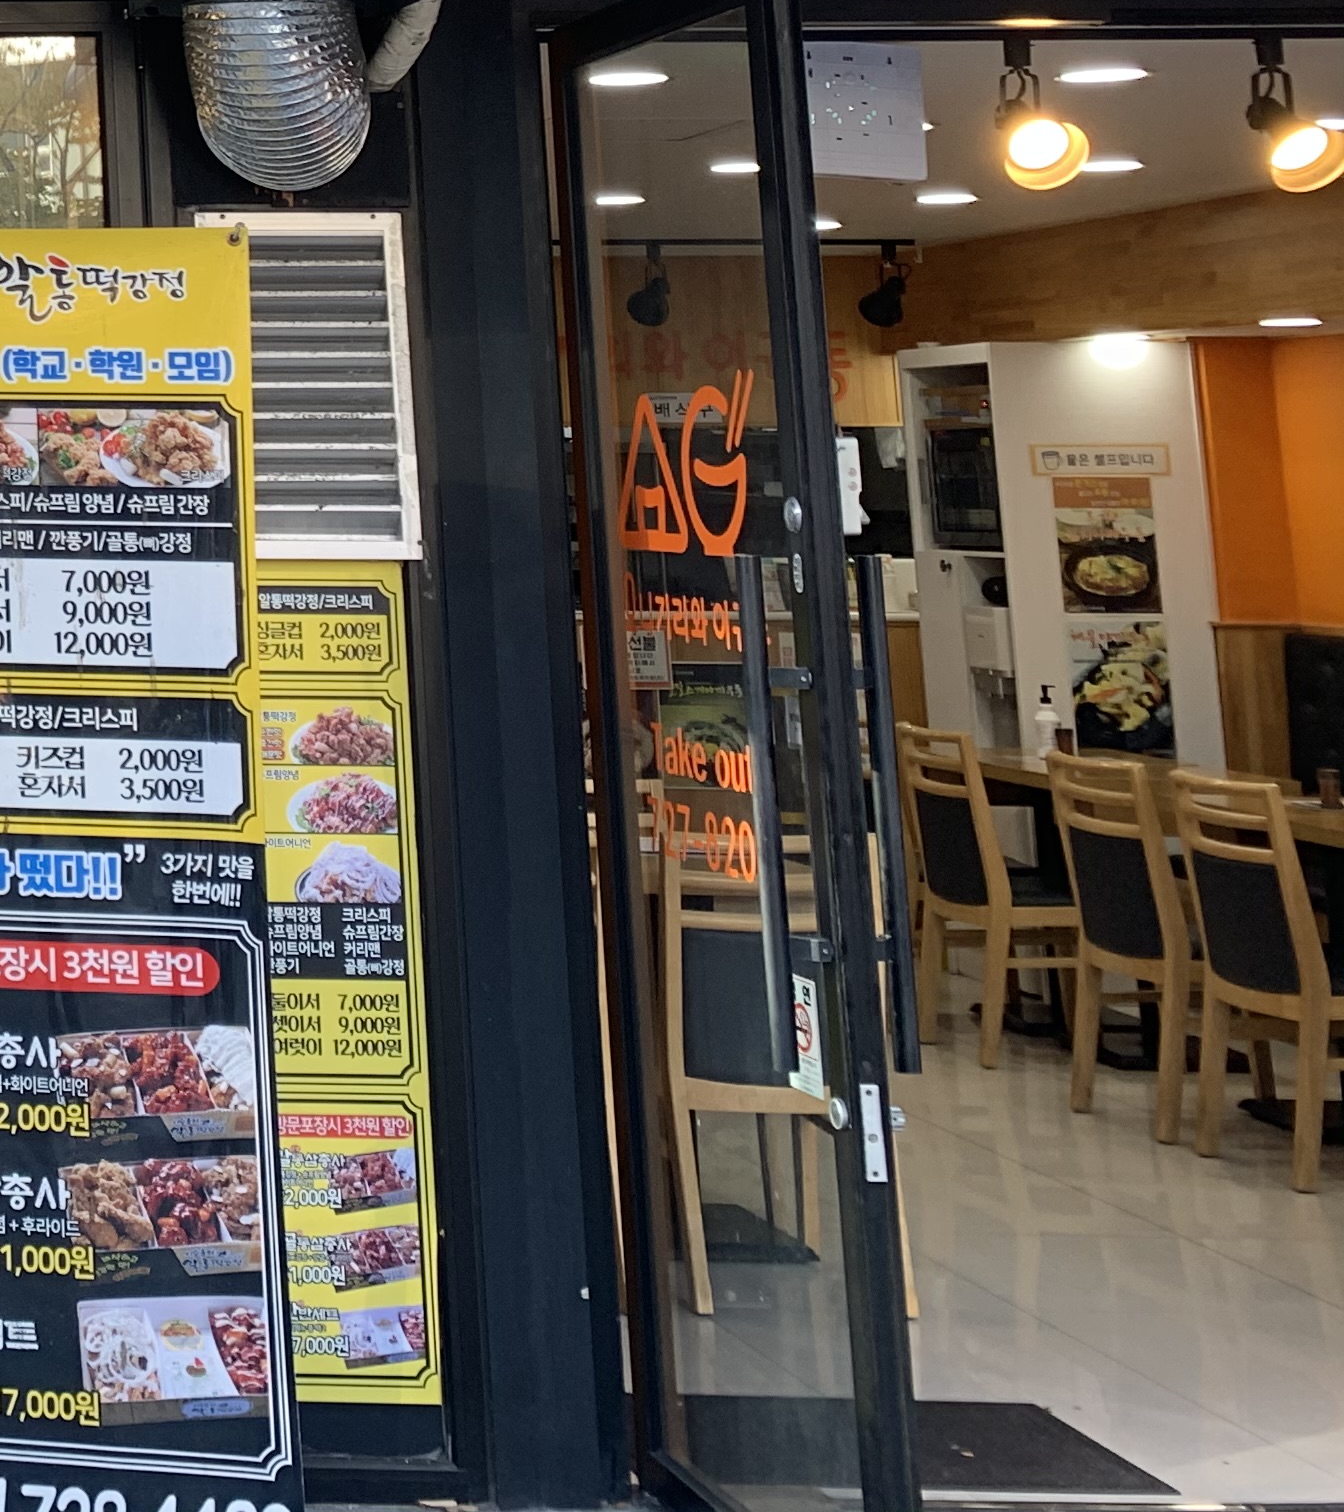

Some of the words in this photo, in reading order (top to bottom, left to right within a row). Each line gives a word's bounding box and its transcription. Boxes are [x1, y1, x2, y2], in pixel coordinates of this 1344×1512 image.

[2, 349, 69, 382] (학교
[88, 350, 144, 381] 학원
[167, 351, 234, 384] 모임)
[60, 569, 152, 596] 7,000원
[258, 592, 374, 610] 알통떡강정/크리스피
[61, 600, 153, 627] 9,000원
[319, 621, 382, 641] 2,000원
[54, 631, 153, 659] 12,000원
[320, 643, 382, 663] 3,500원
[262, 711, 297, 722] 통떡강정
[16, 745, 85, 771] 키즈컵
[118, 748, 204, 775] 2,000원
[653, 721, 708, 782] Take
[263, 769, 300, 782] 프림양념
[17, 775, 87, 801] 혼자서
[120, 777, 205, 804] 3,500원
[648, 796, 759, 884] 727-820
[160, 850, 214, 878] 3가지
[218, 853, 255, 882] 맛을
[170, 880, 243, 908] 한번에!!
[341, 907, 392, 924] 크리스피
[342, 925, 405, 942] 슈프림간장
[343, 942, 381, 959] 커리맨
[62, 948, 140, 986] 3천원
[144, 951, 205, 989] 할인
[337, 993, 401, 1013] 7,000원
[273, 1015, 322, 1035] 셋이서
[338, 1016, 402, 1036] 9,000원
[274, 1037, 323, 1057] 여럿이
[333, 1038, 403, 1059] 12,000원
[343, 1117, 380, 1136] 3천원
[381, 1118, 410, 1137] 할인
[20, 1216, 82, 1238] 후라이드
[289, 1265, 346, 1287] 1,000원
